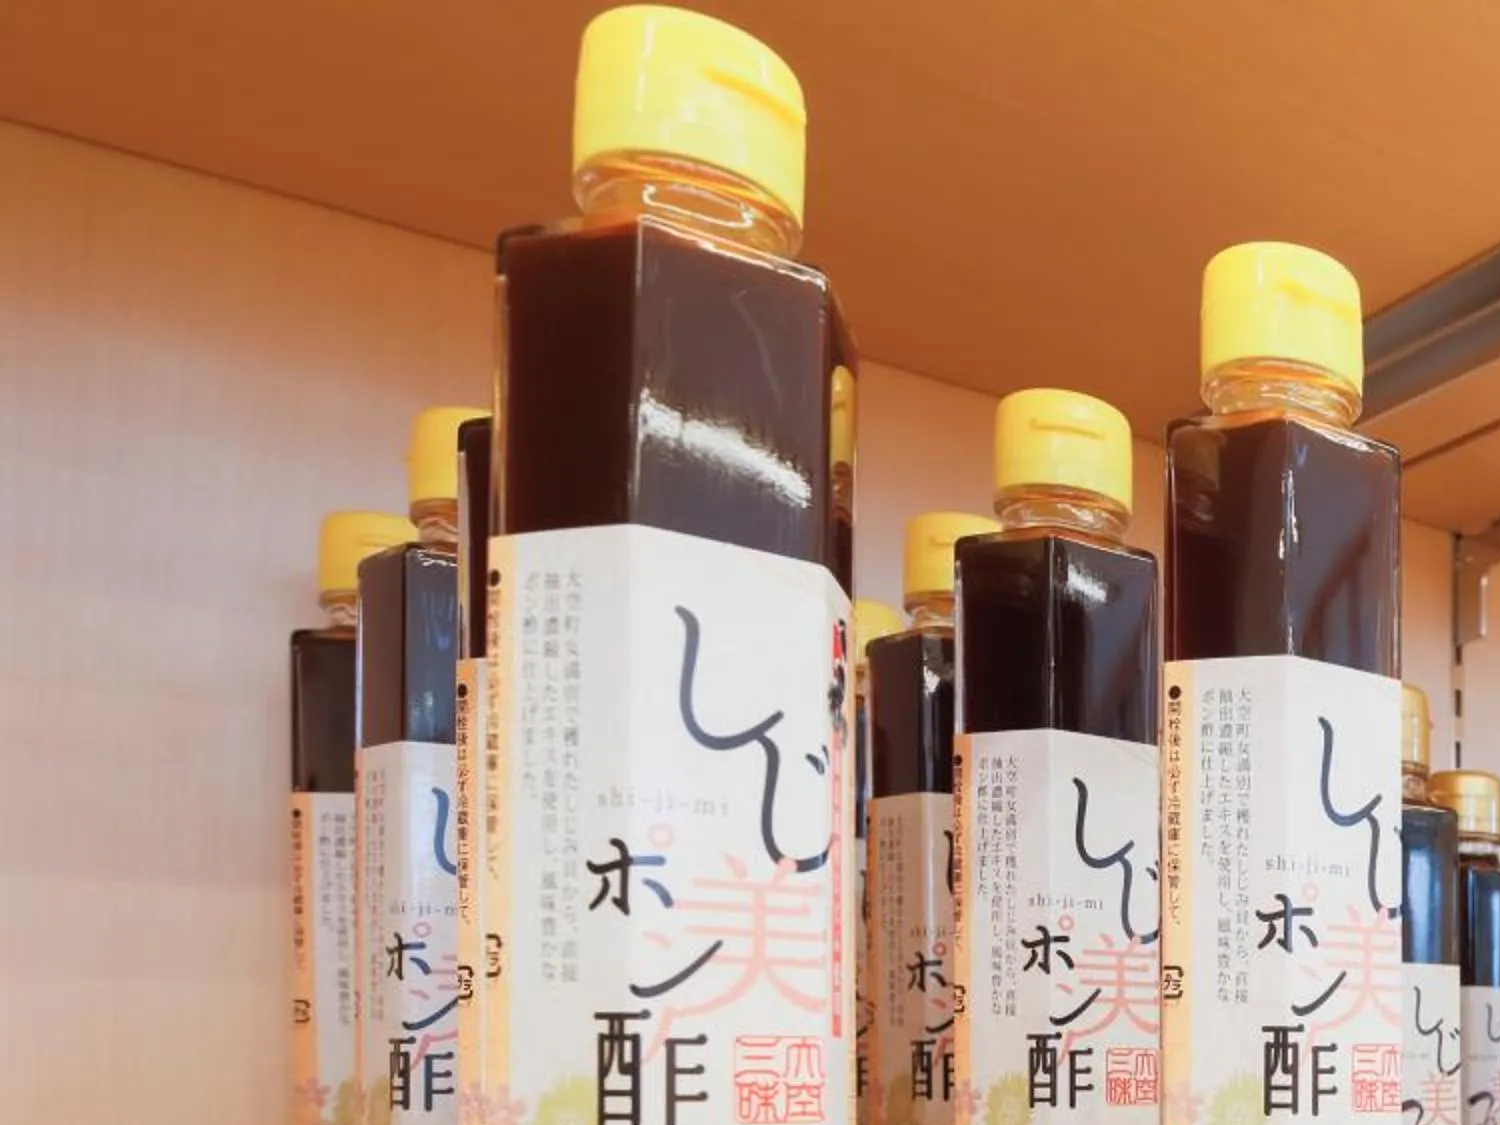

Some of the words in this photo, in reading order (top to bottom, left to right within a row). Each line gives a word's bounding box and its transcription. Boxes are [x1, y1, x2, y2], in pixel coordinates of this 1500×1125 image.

[1021, 914, 1102, 1109] ポン酢
[1256, 883, 1346, 1116] ポン酢
